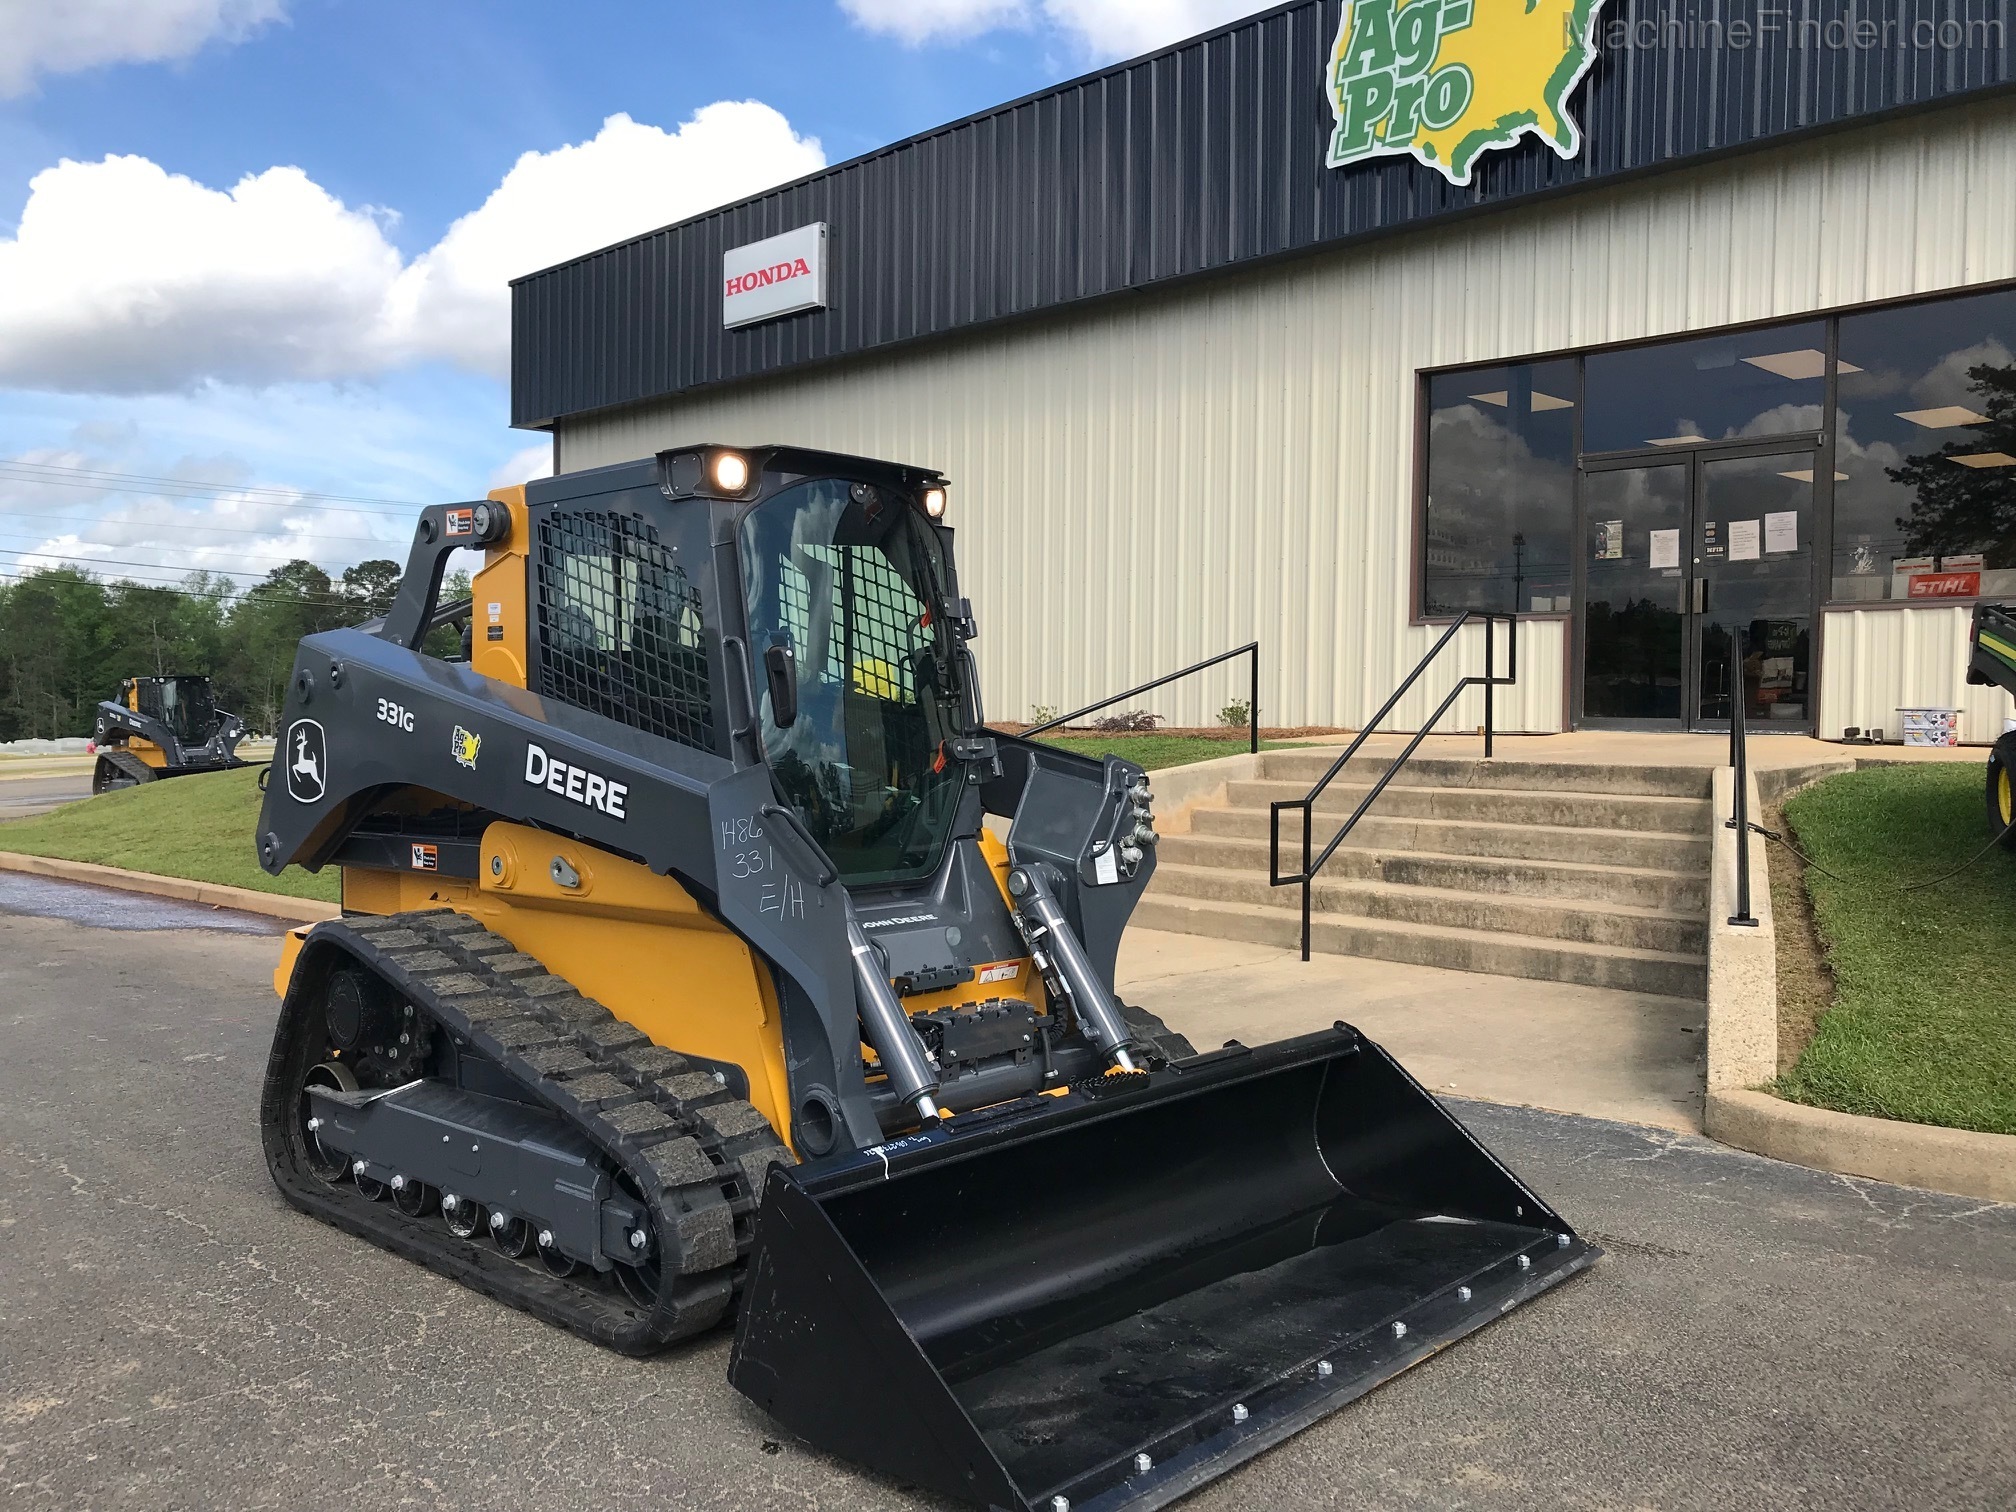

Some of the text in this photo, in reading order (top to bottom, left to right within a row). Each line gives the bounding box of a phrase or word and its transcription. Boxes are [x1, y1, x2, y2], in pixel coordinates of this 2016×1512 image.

[1338, 0, 1473, 82] Ag-
[1335, 64, 1472, 157] Pro
[726, 258, 811, 297] HONDA
[1912, 580, 1970, 595] STIHL
[377, 698, 415, 732] 331G
[453, 740, 467, 755] Pro
[525, 743, 628, 819] DEERE
[721, 816, 763, 850] 1486
[732, 845, 773, 878] 331
[760, 874, 804, 921] E/H
[862, 914, 938, 929] JOHN DEERE
